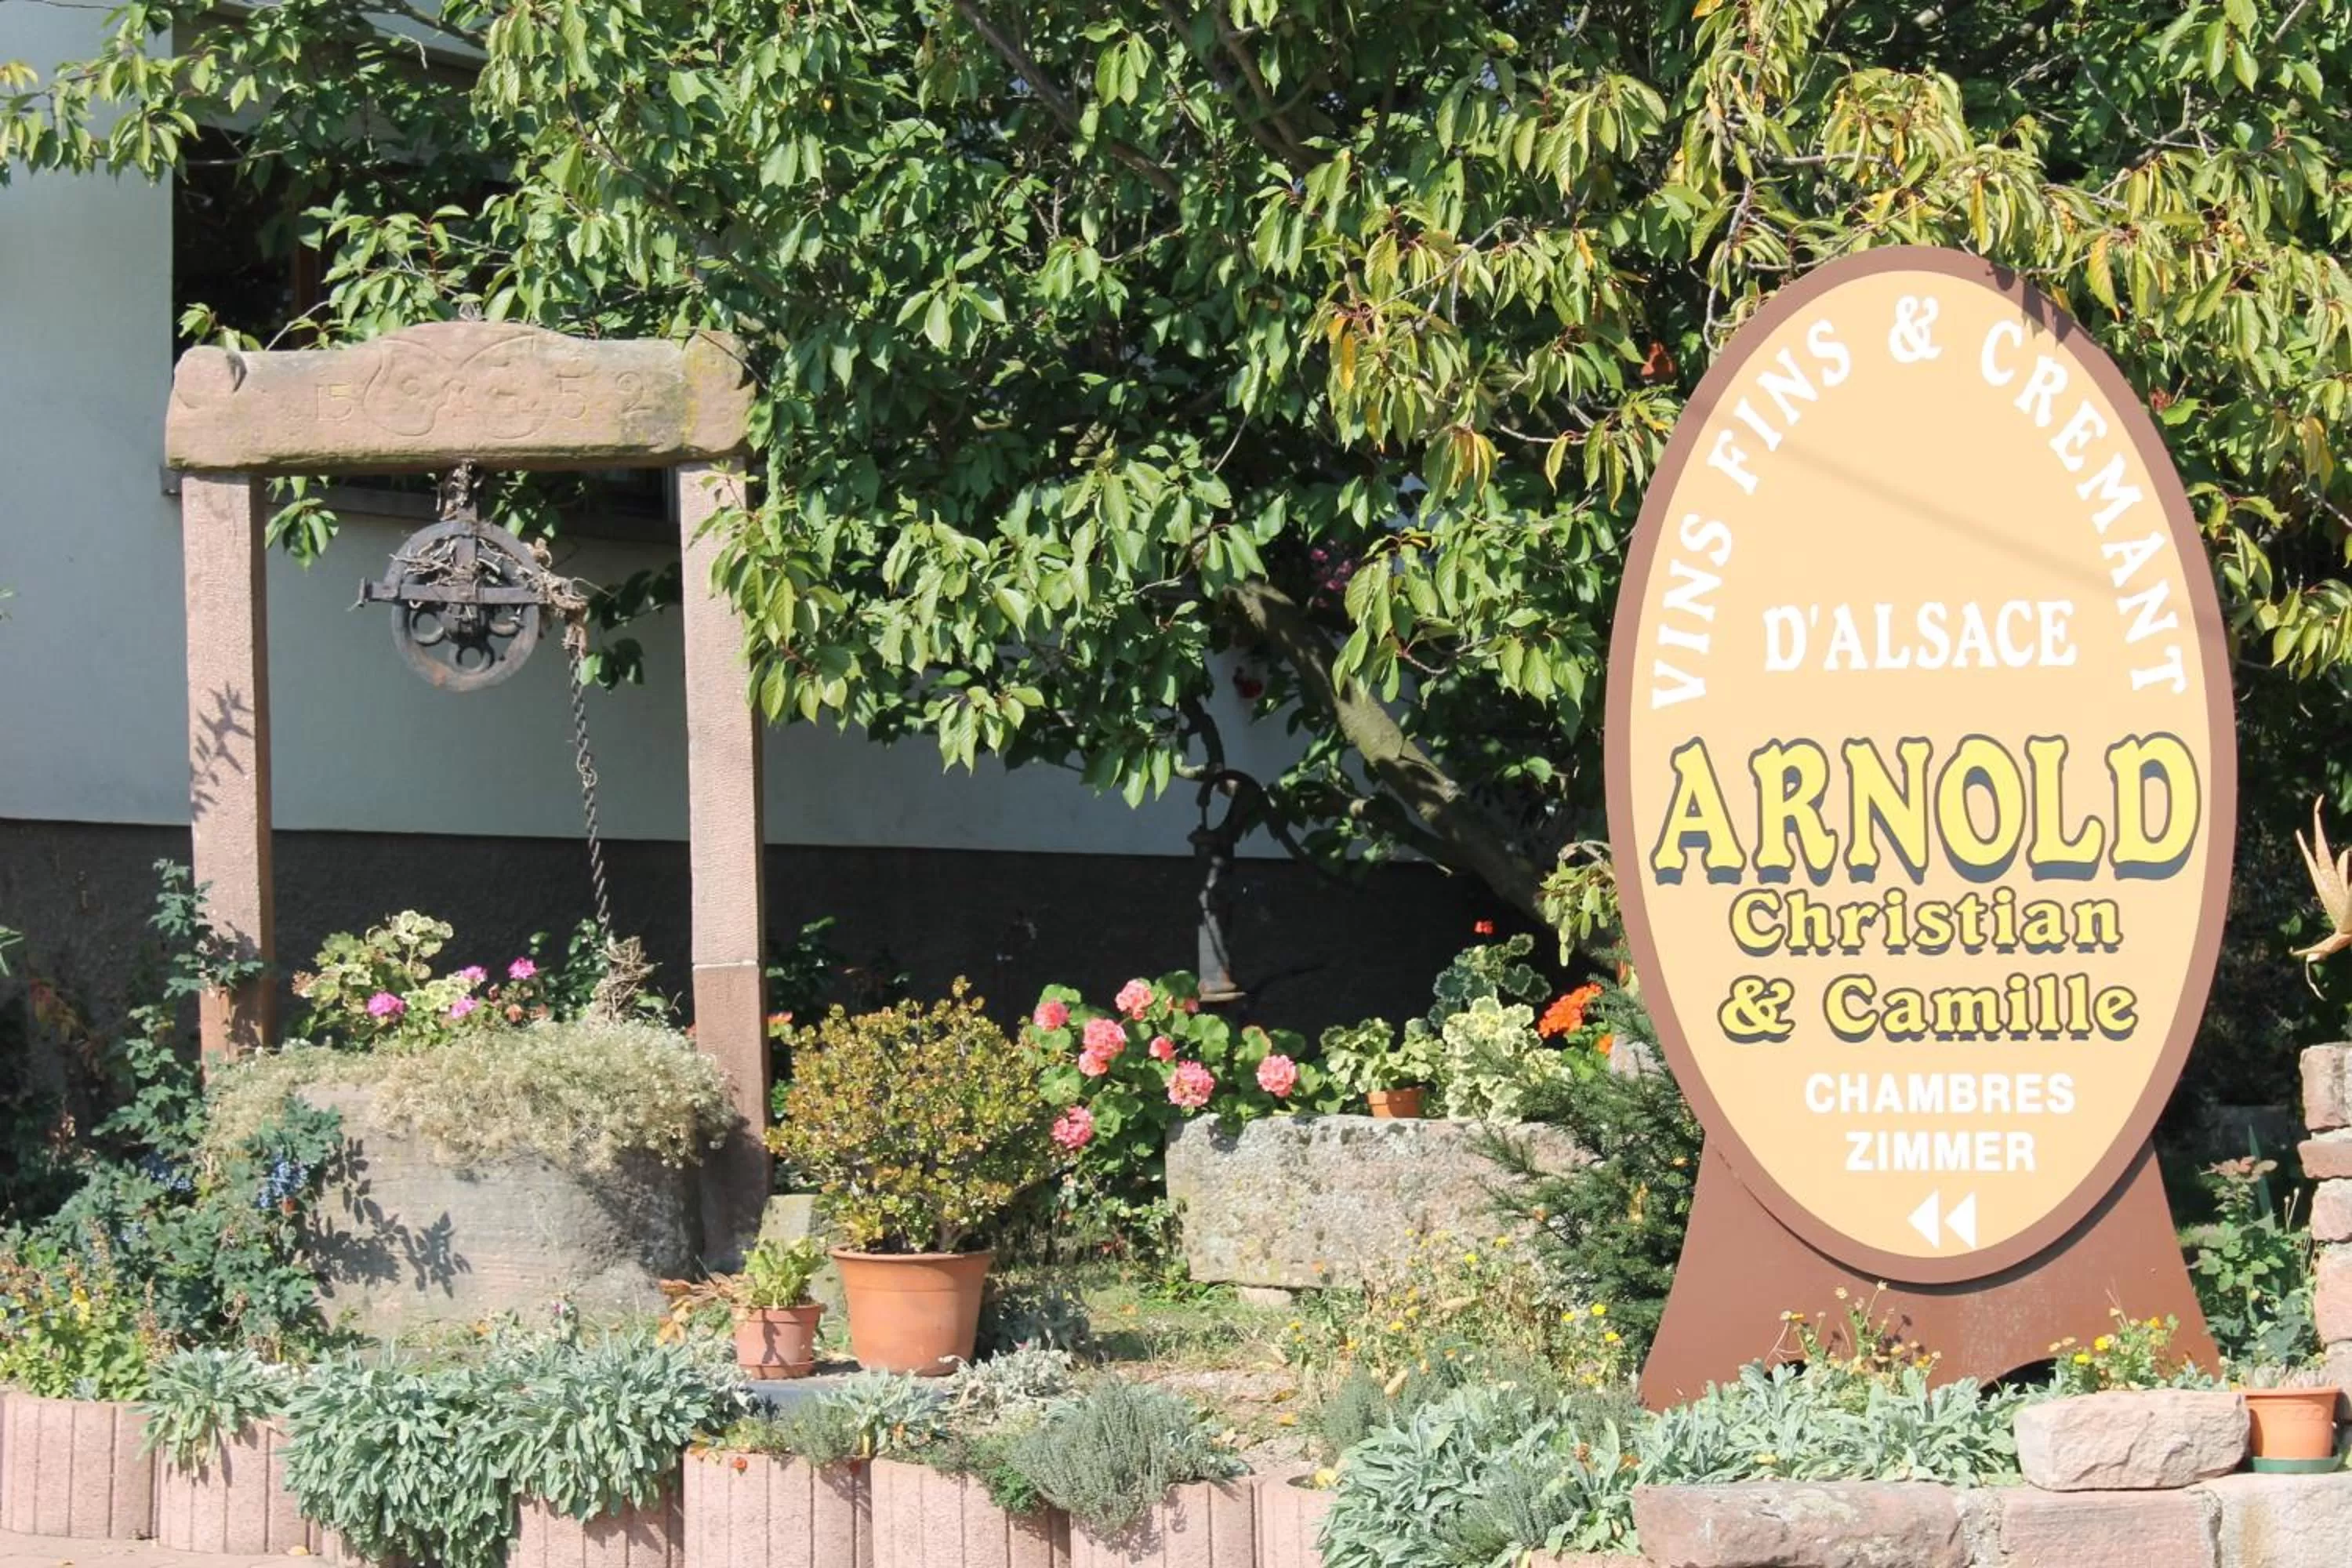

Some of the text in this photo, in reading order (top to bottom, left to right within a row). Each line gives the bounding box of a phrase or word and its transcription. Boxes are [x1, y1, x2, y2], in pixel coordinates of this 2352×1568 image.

[1651, 295, 2187, 710] VINS FINS & CREMANT
[1763, 600, 2076, 672] D'ALSACE
[1650, 731, 2201, 886] ARNOLD
[1729, 886, 2124, 956] Christian
[1717, 972, 2139, 1044] & Camille
[1806, 1072, 2075, 1113] CHAMBRES
[1845, 1131, 2036, 1171] ZIMMER
